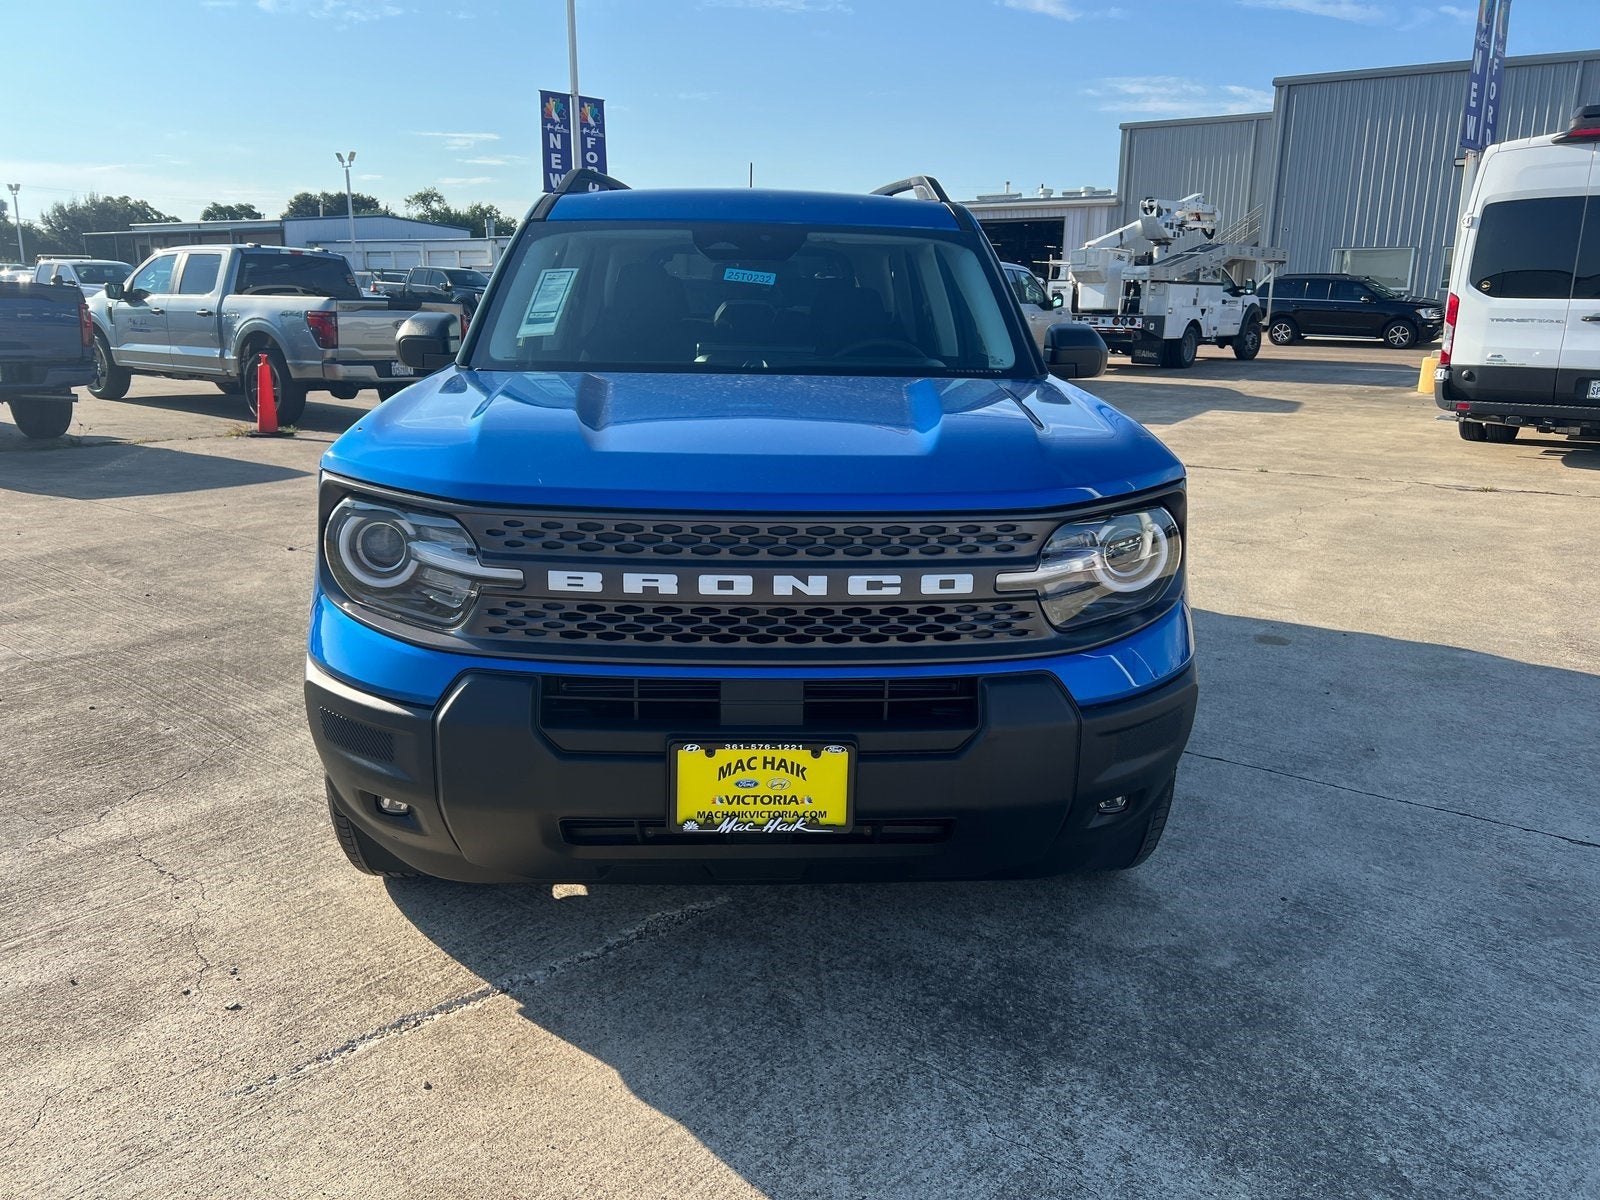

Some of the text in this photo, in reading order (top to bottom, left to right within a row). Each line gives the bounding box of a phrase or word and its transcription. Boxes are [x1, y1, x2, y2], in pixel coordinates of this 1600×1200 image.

[1467, 48, 1483, 141] NEW
[1486, 57, 1500, 146] FORD
[549, 132, 566, 190] NEW
[727, 271, 772, 283] 25T0232
[547, 570, 974, 596] BRONCO
[717, 756, 807, 781] MAC HAIK
[724, 794, 800, 806] VICTORIA
[696, 810, 827, 819] MACHAIKVICTORIACOM
[716, 817, 810, 833] Mac Haik
